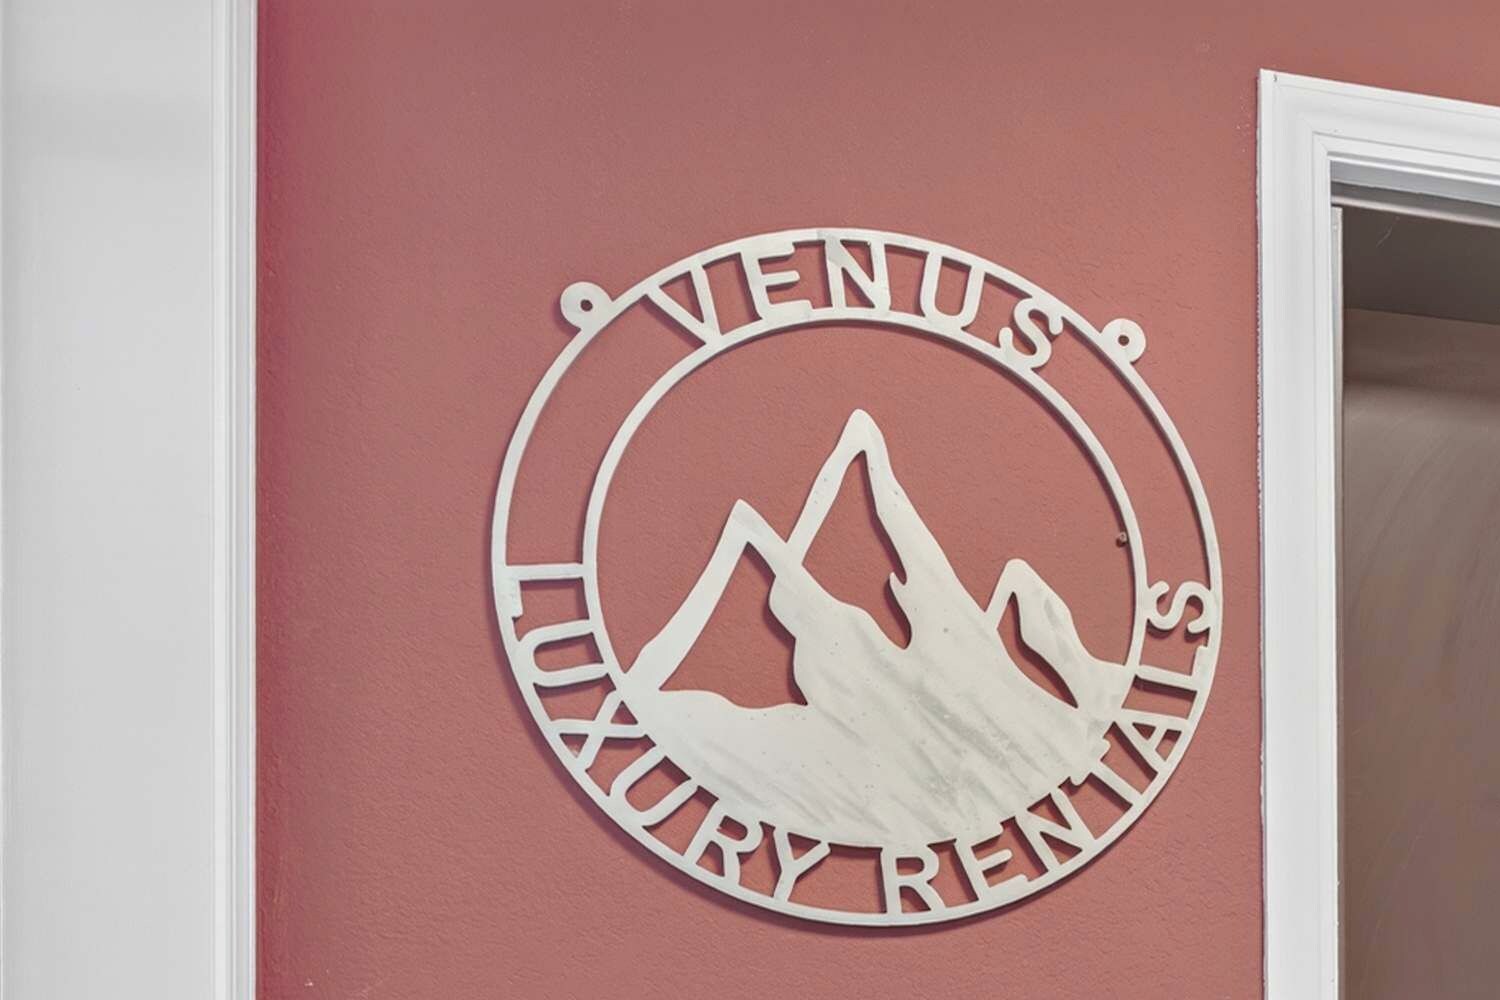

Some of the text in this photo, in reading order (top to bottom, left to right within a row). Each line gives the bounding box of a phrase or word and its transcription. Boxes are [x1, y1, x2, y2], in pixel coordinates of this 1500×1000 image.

[643, 238, 1066, 371] VENUS
[499, 564, 1216, 915] LUXURY RENTALS
